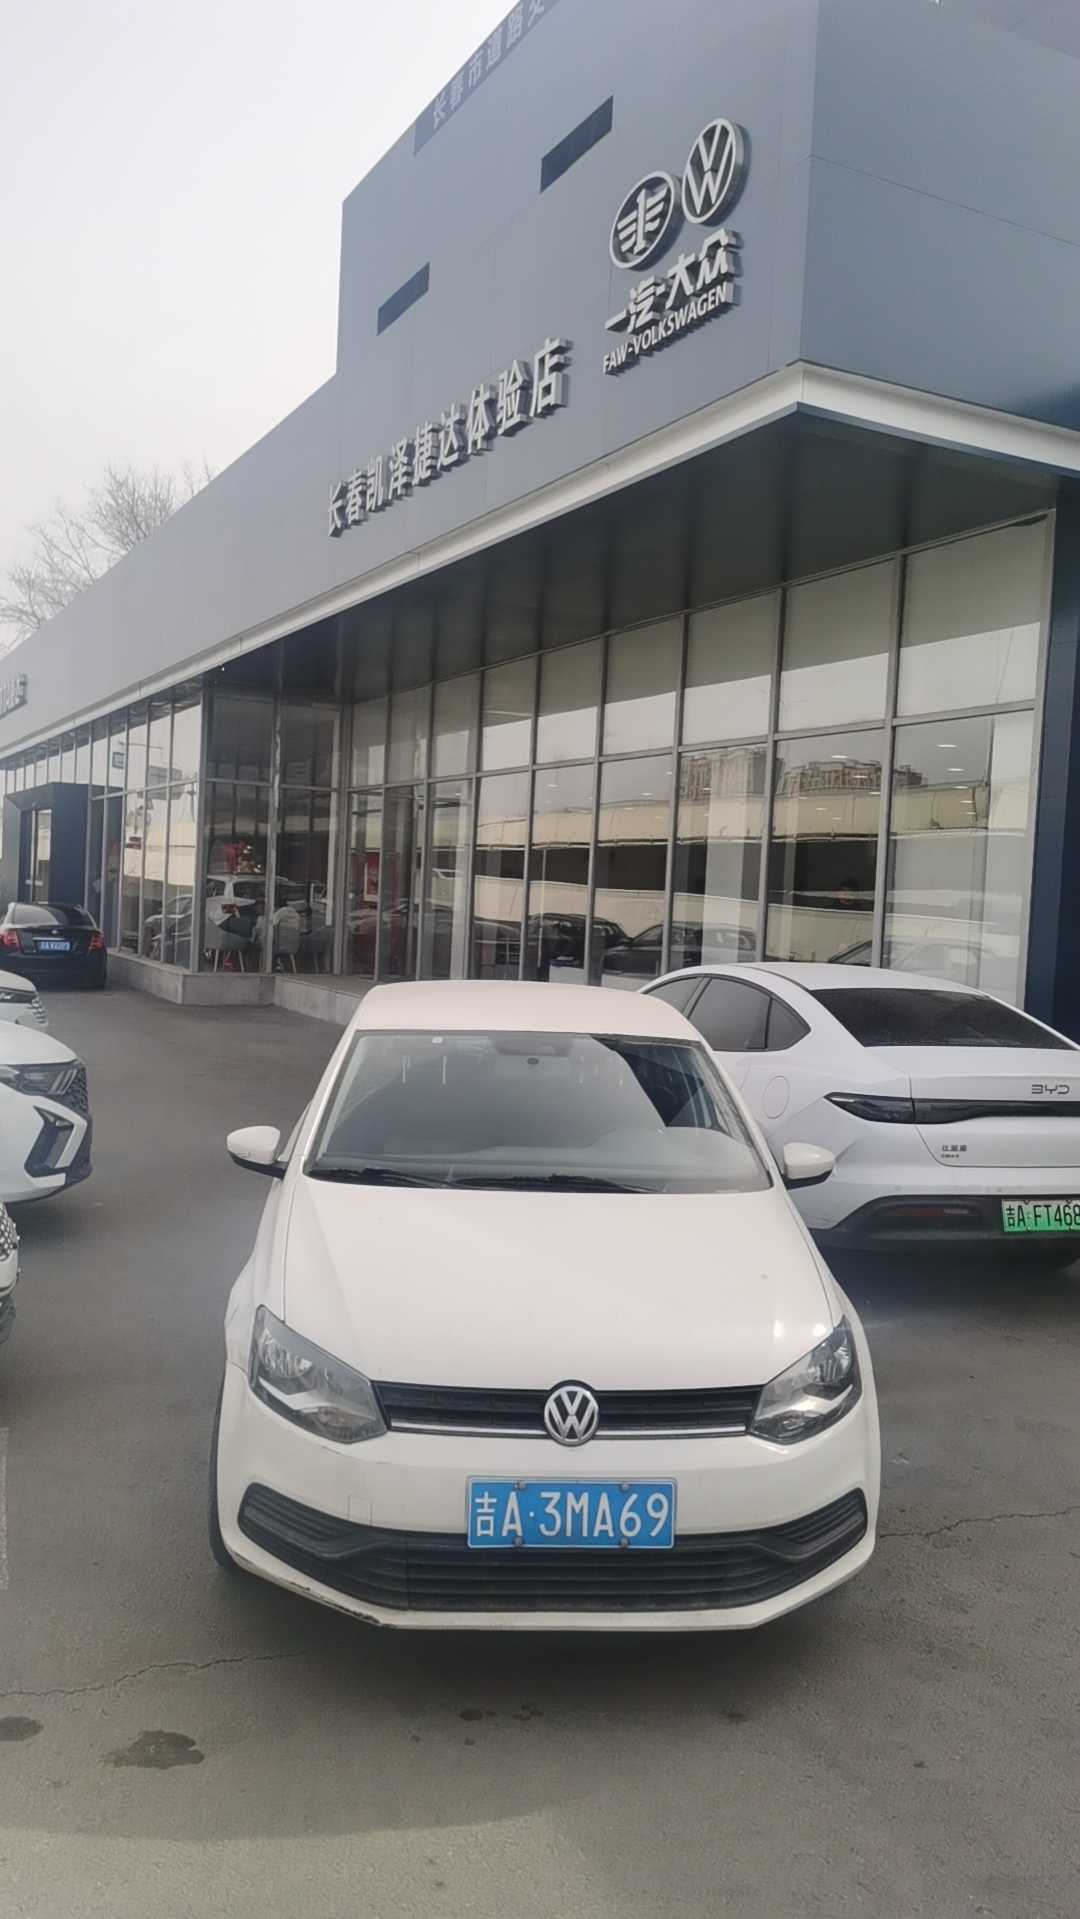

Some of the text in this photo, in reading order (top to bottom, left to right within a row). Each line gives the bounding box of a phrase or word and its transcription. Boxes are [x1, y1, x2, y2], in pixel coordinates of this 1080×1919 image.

[603, 282, 728, 374] FAW-VOLKSWAGEN
[328, 337, 568, 536] 长春凯泽捷达体验店
[1031, 1084, 1070, 1095] BYD
